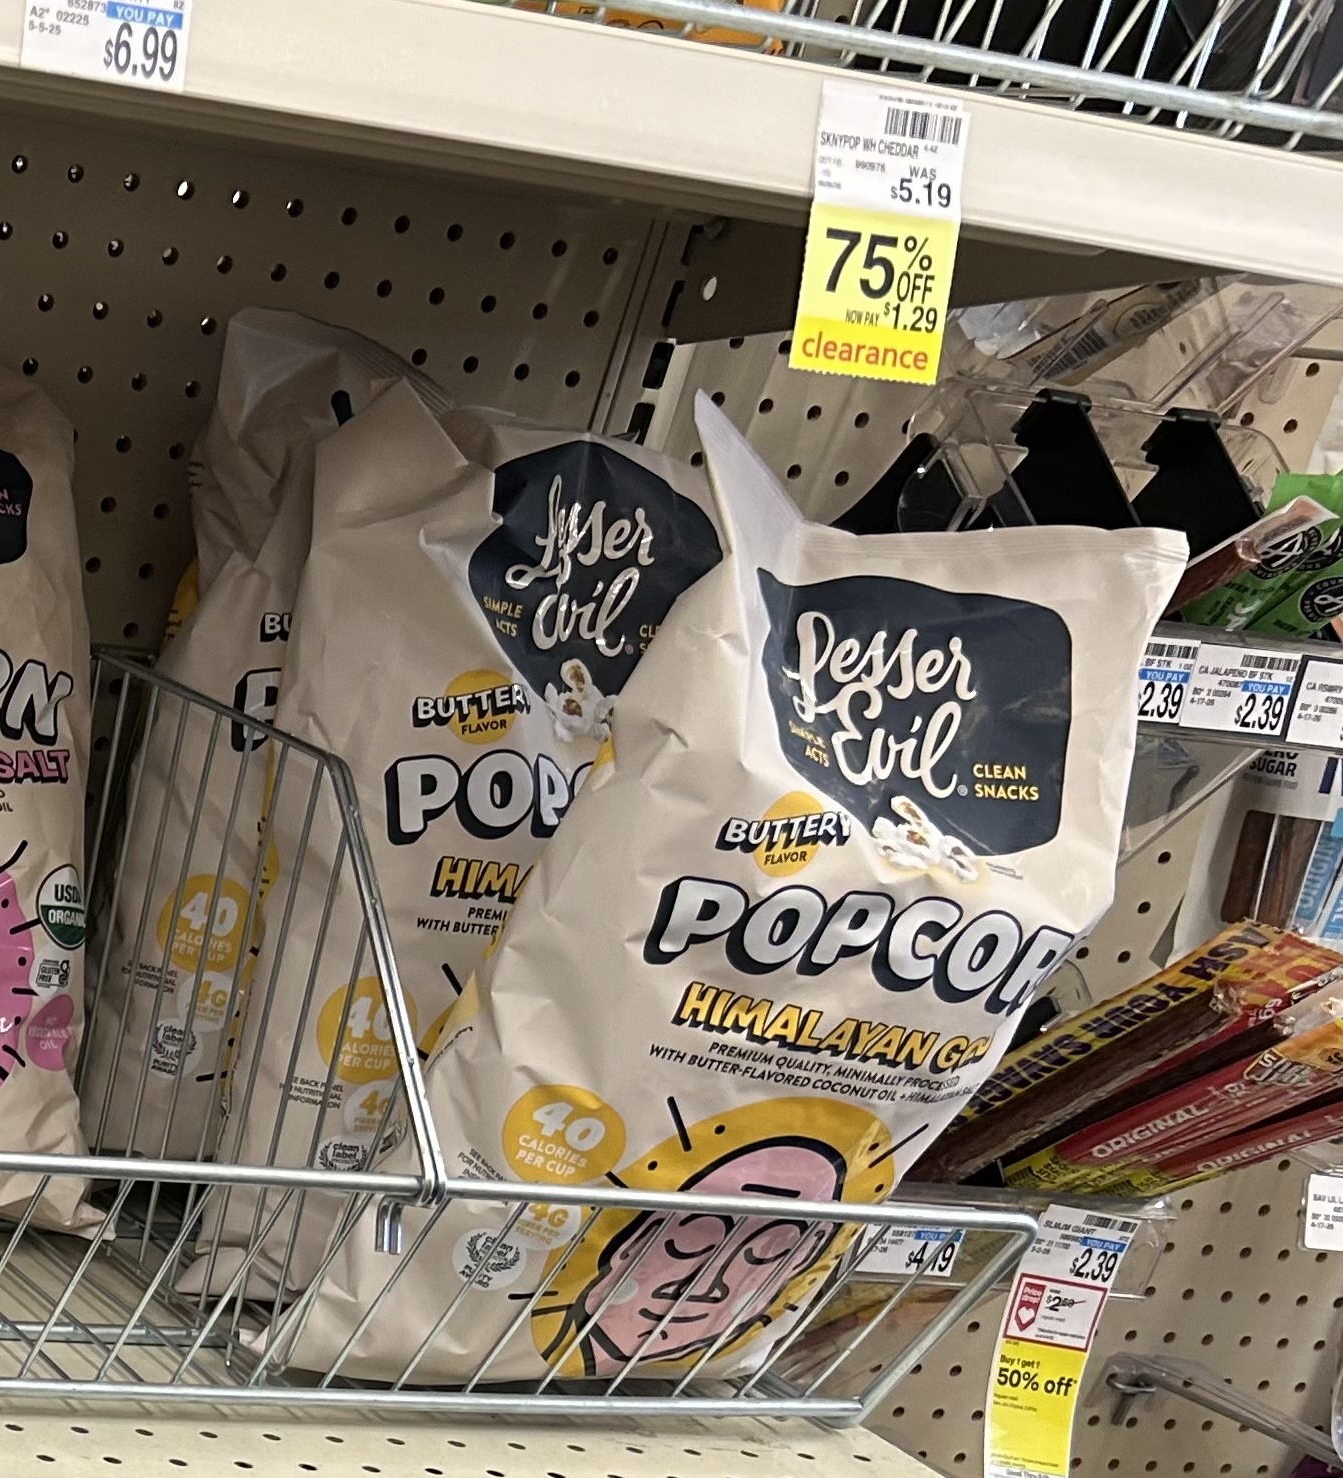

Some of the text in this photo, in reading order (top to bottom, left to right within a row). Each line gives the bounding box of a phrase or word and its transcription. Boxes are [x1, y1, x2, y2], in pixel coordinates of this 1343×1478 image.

[116, 5, 174, 25] YOU PAY
[104, 22, 178, 81] $6.99
[890, 178, 952, 207] $5.19
[825, 228, 935, 304] 75% OFF
[802, 332, 928, 371] clearance
[482, 594, 524, 621] SIMPLE
[784, 610, 977, 722] Lesser
[461, 716, 508, 736] FLAVOR
[1234, 693, 1284, 731] $2.39
[972, 762, 1027, 782] CLEAN
[1249, 759, 1297, 778] SUGAR
[973, 782, 1039, 801] SNACKS
[715, 808, 853, 854] BUTTERY
[764, 850, 808, 867] FLAVOR
[416, 916, 449, 934] WITH
[671, 981, 942, 1073] HIMALAYAN
[533, 1101, 606, 1151] 40
[1091, 1101, 1211, 1161] ORIGINAL
[516, 1150, 576, 1176] PER CUP
[518, 1134, 589, 1168] CALORIES
[1069, 1249, 1118, 1282] $2.39
[997, 1368, 1039, 1391] 50%
